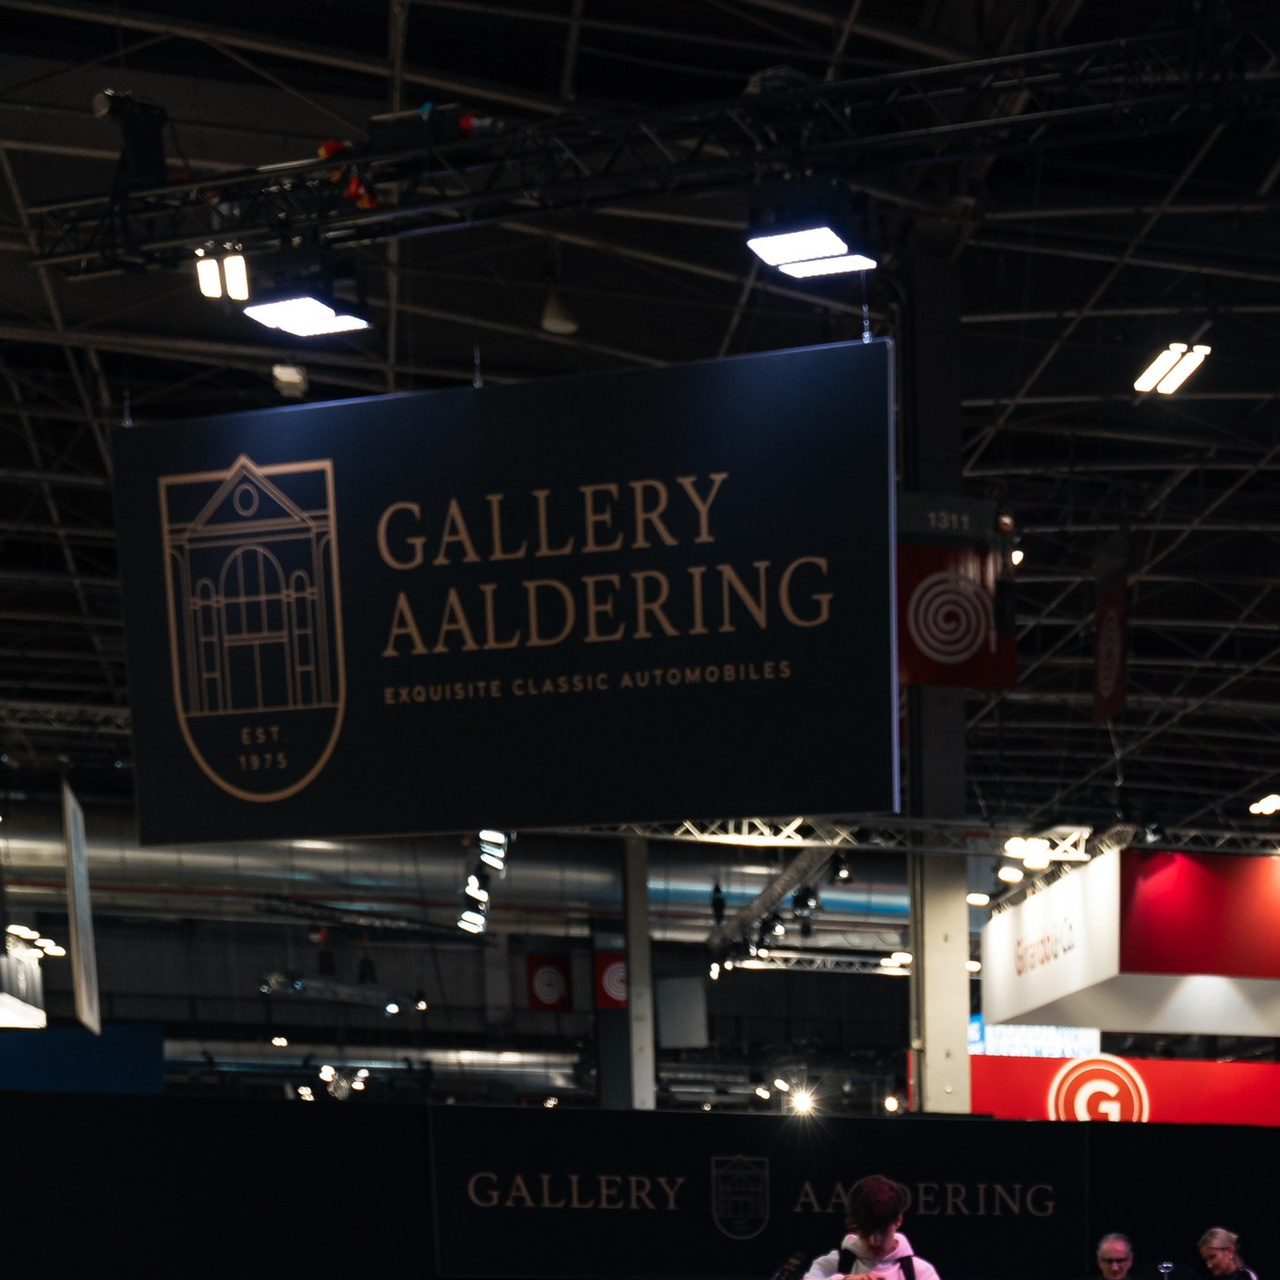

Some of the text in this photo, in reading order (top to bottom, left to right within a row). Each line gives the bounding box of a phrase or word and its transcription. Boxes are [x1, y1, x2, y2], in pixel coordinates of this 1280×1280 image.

[377, 472, 730, 570] GALLERY
[927, 511, 970, 530] 1311
[382, 556, 835, 659] AALDERING
[383, 659, 793, 706] EXQUISITE CLASSIC AUTOMOBILES
[239, 750, 288, 771] 1975
[467, 1172, 1056, 1217] GALLERY AADERING
